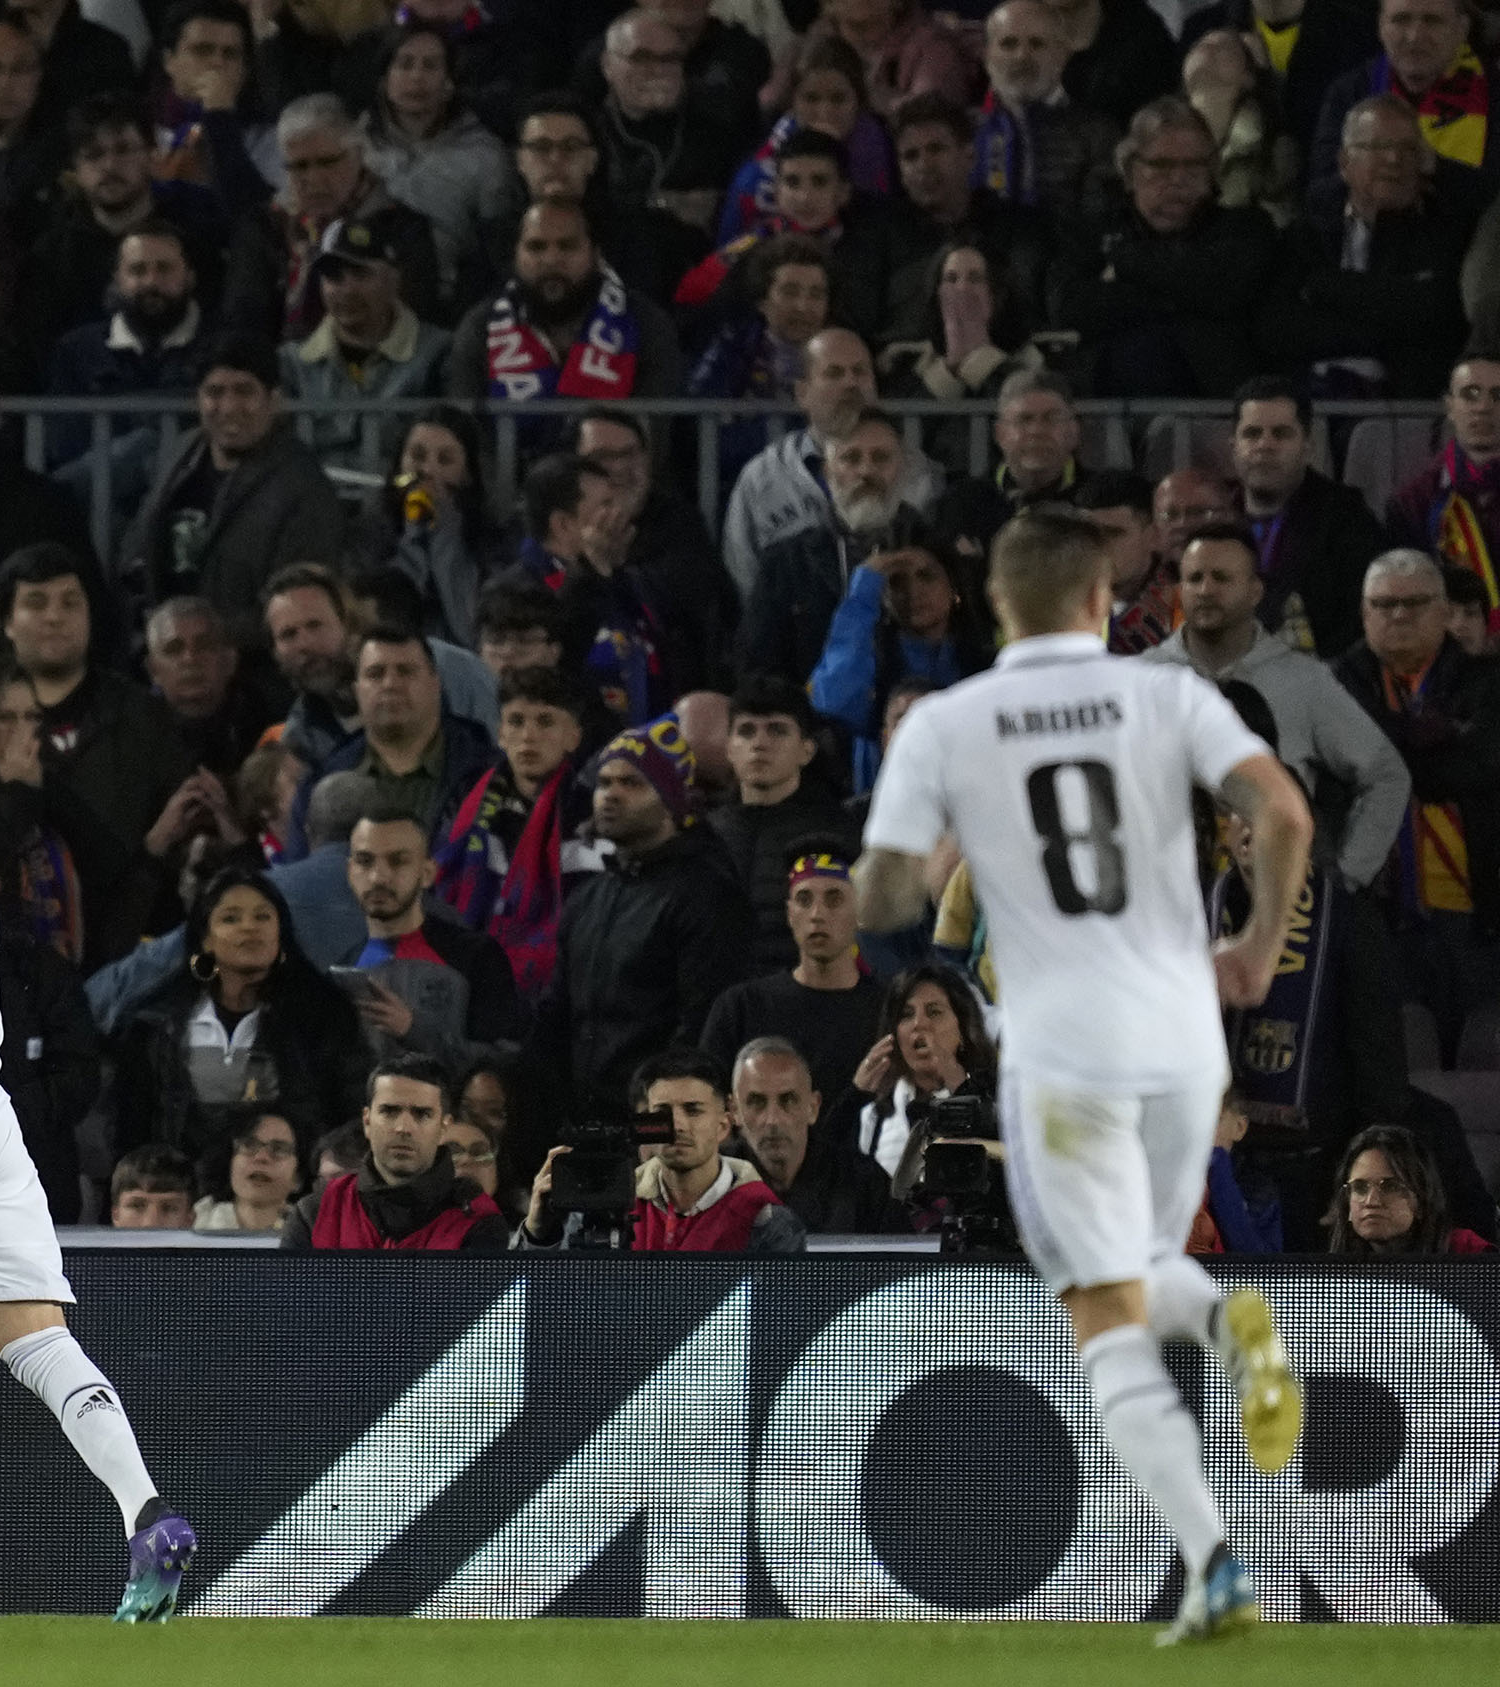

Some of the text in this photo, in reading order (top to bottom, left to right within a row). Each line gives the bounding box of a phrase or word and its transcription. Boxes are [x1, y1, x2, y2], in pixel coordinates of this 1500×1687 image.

[580, 319, 624, 384] FC
[996, 698, 1123, 737] KROOS
[1027, 759, 1128, 916] 8
